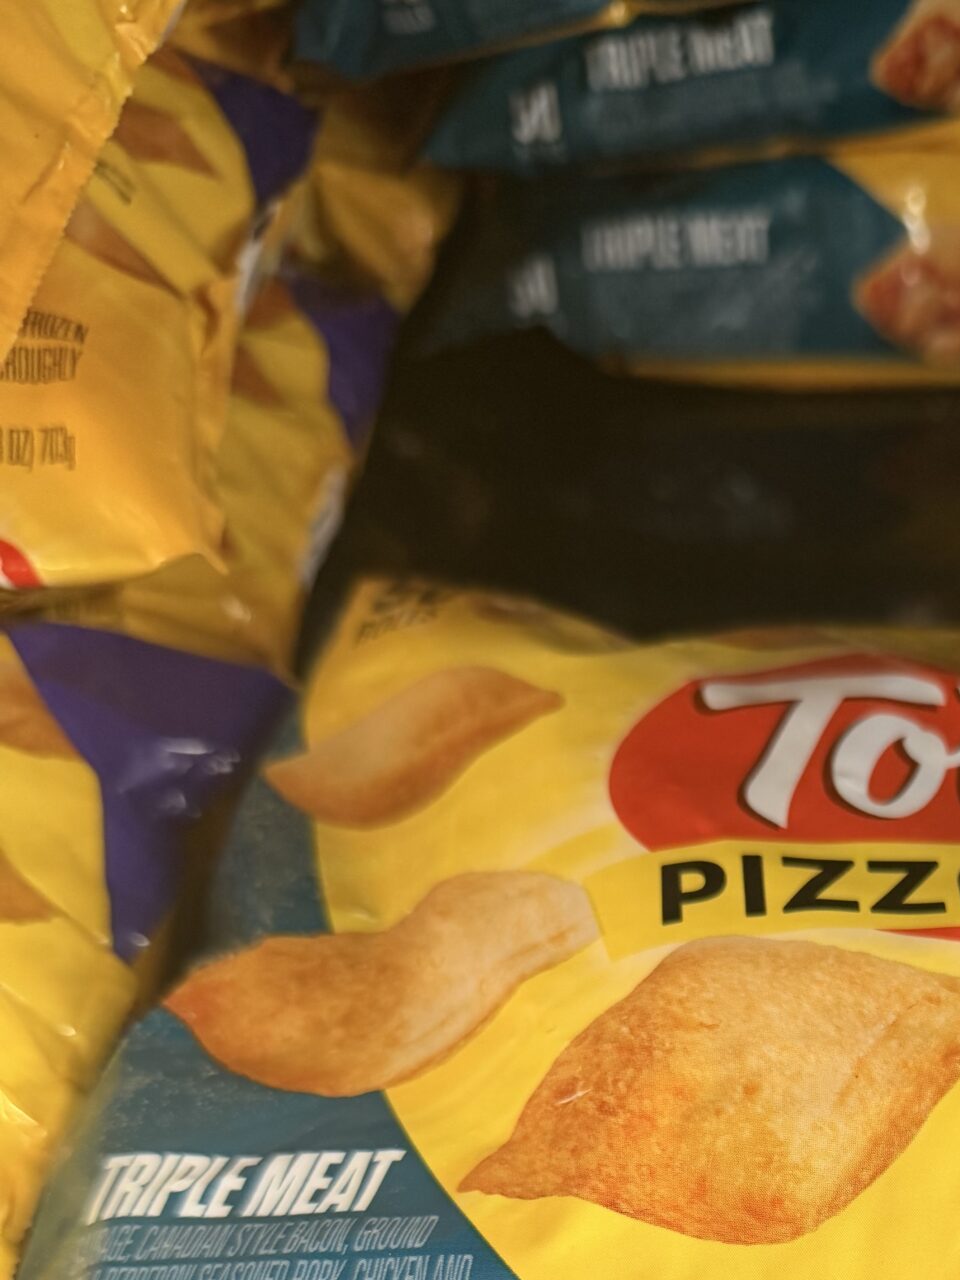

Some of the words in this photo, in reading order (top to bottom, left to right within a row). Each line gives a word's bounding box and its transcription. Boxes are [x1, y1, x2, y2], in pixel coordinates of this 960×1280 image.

[86, 1151, 262, 1226] TRIPLE
[240, 1149, 406, 1217] MEAT
[231, 1218, 293, 1258] STYLE
[352, 1215, 440, 1250] GROUND
